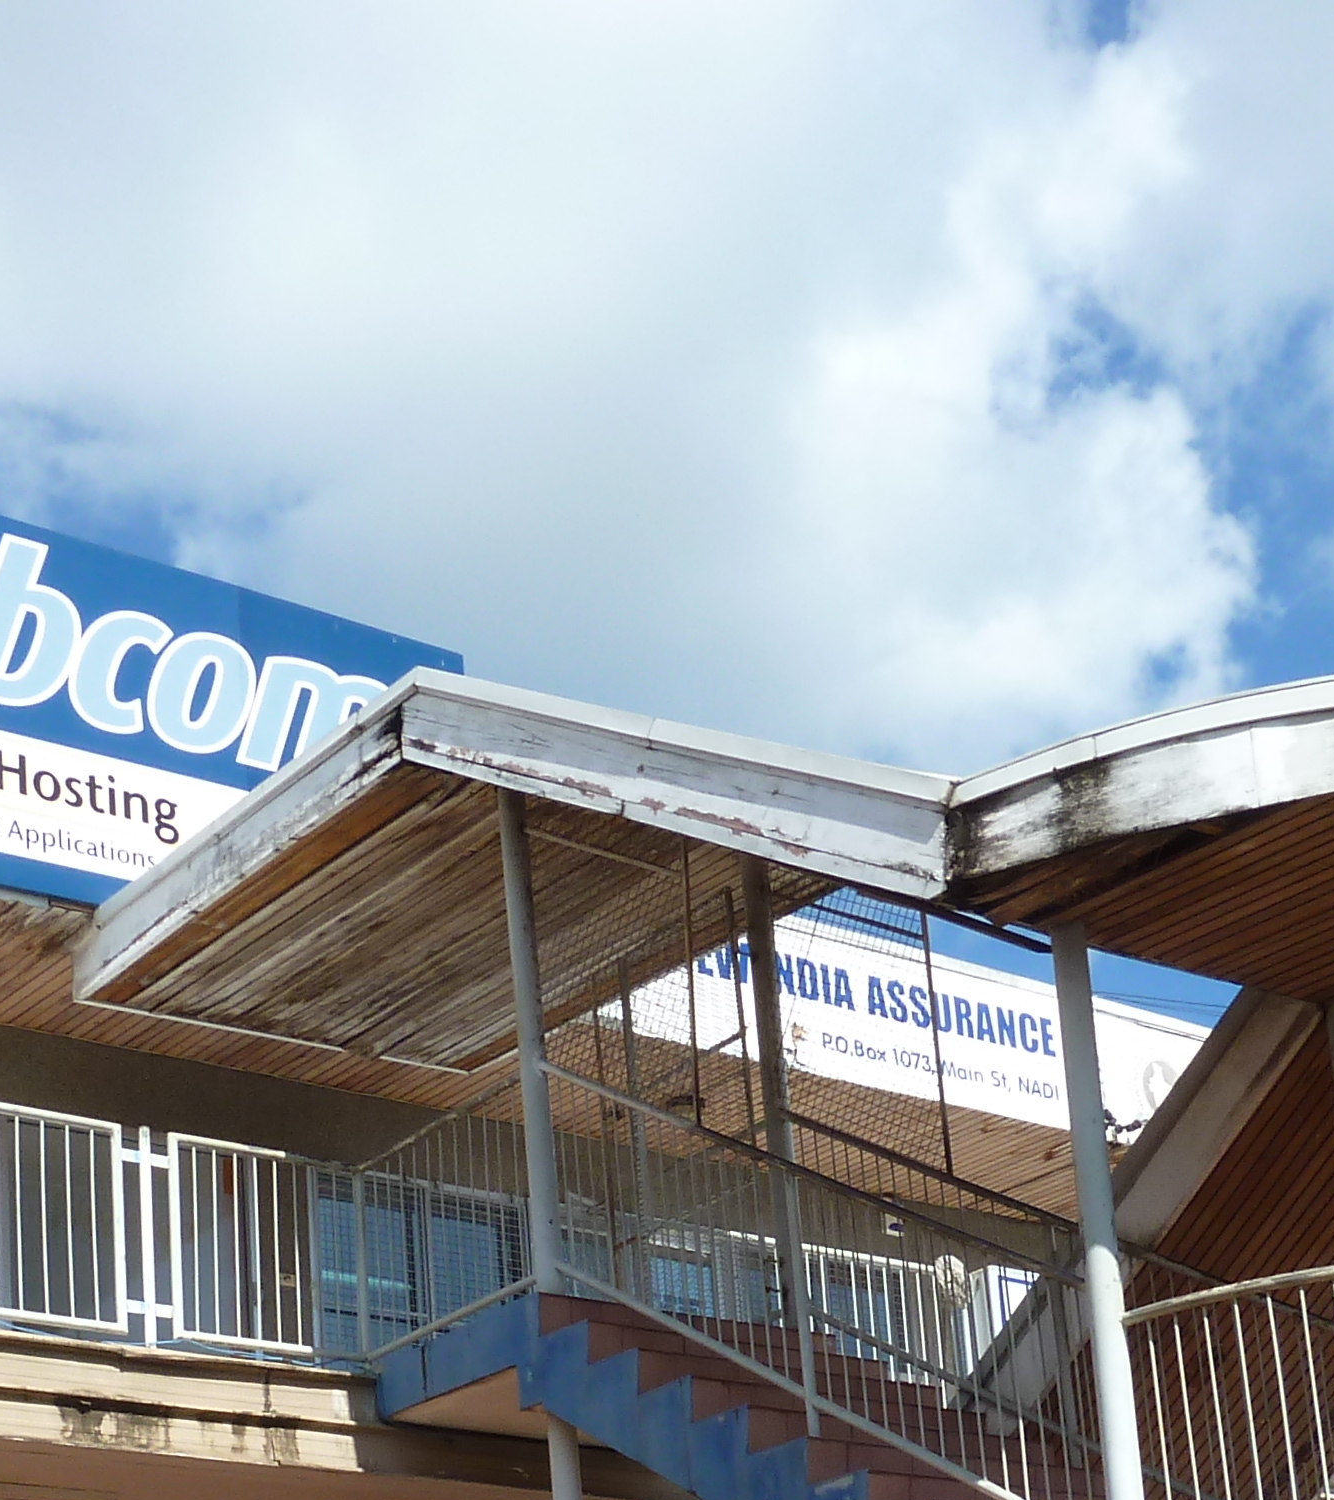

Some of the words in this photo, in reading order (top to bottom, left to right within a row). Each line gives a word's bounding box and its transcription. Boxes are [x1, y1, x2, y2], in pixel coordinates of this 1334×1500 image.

[8, 820, 155, 869] Applications
[773, 951, 855, 1012] NDIA
[867, 975, 1057, 1058] ASSURANCE
[941, 1059, 984, 1084] Main
[1018, 1076, 1060, 1101] NADI
